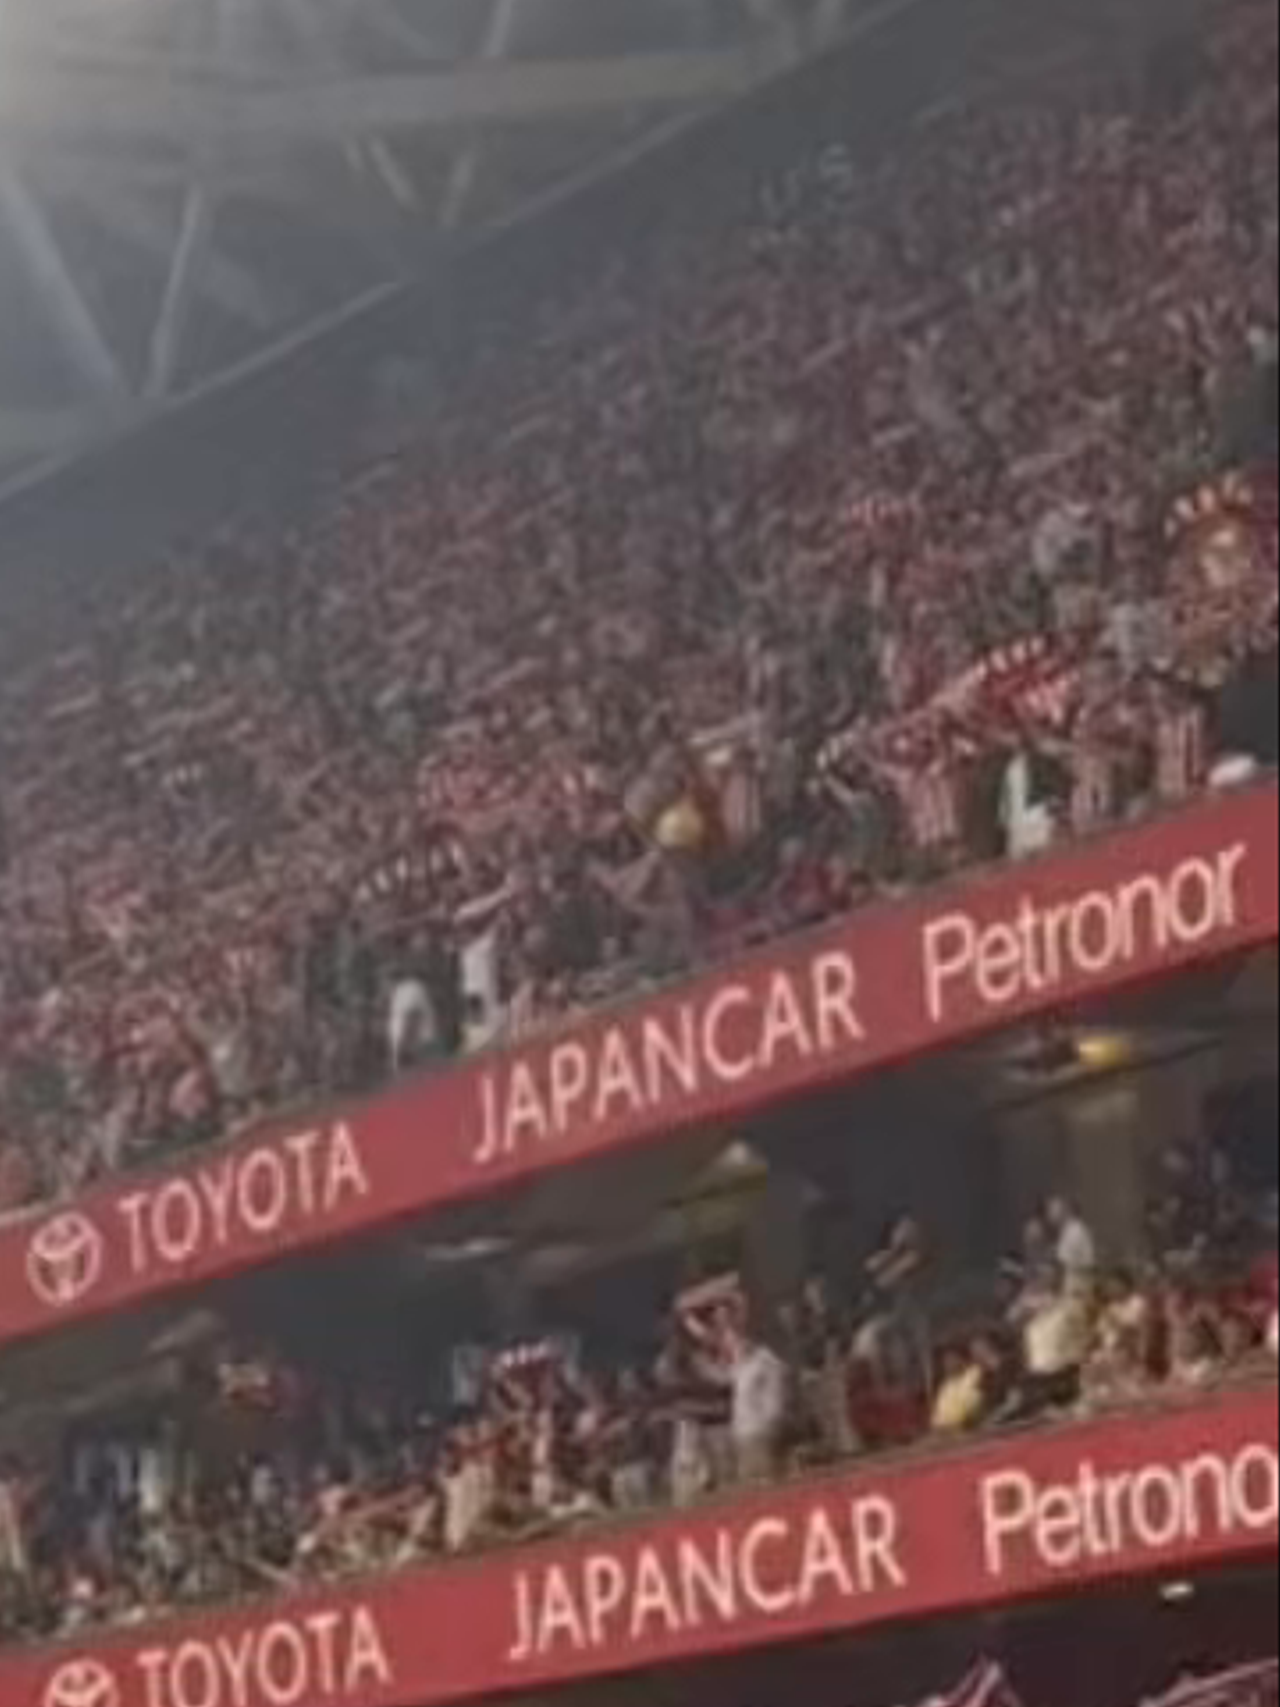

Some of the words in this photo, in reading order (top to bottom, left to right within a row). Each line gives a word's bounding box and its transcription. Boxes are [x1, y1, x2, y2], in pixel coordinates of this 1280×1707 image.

[923, 842, 1246, 1022] Petronor
[472, 950, 867, 1164] JAPANCAR
[117, 1119, 370, 1275] TOYOTA
[508, 1493, 907, 1661] JAPANCAR
